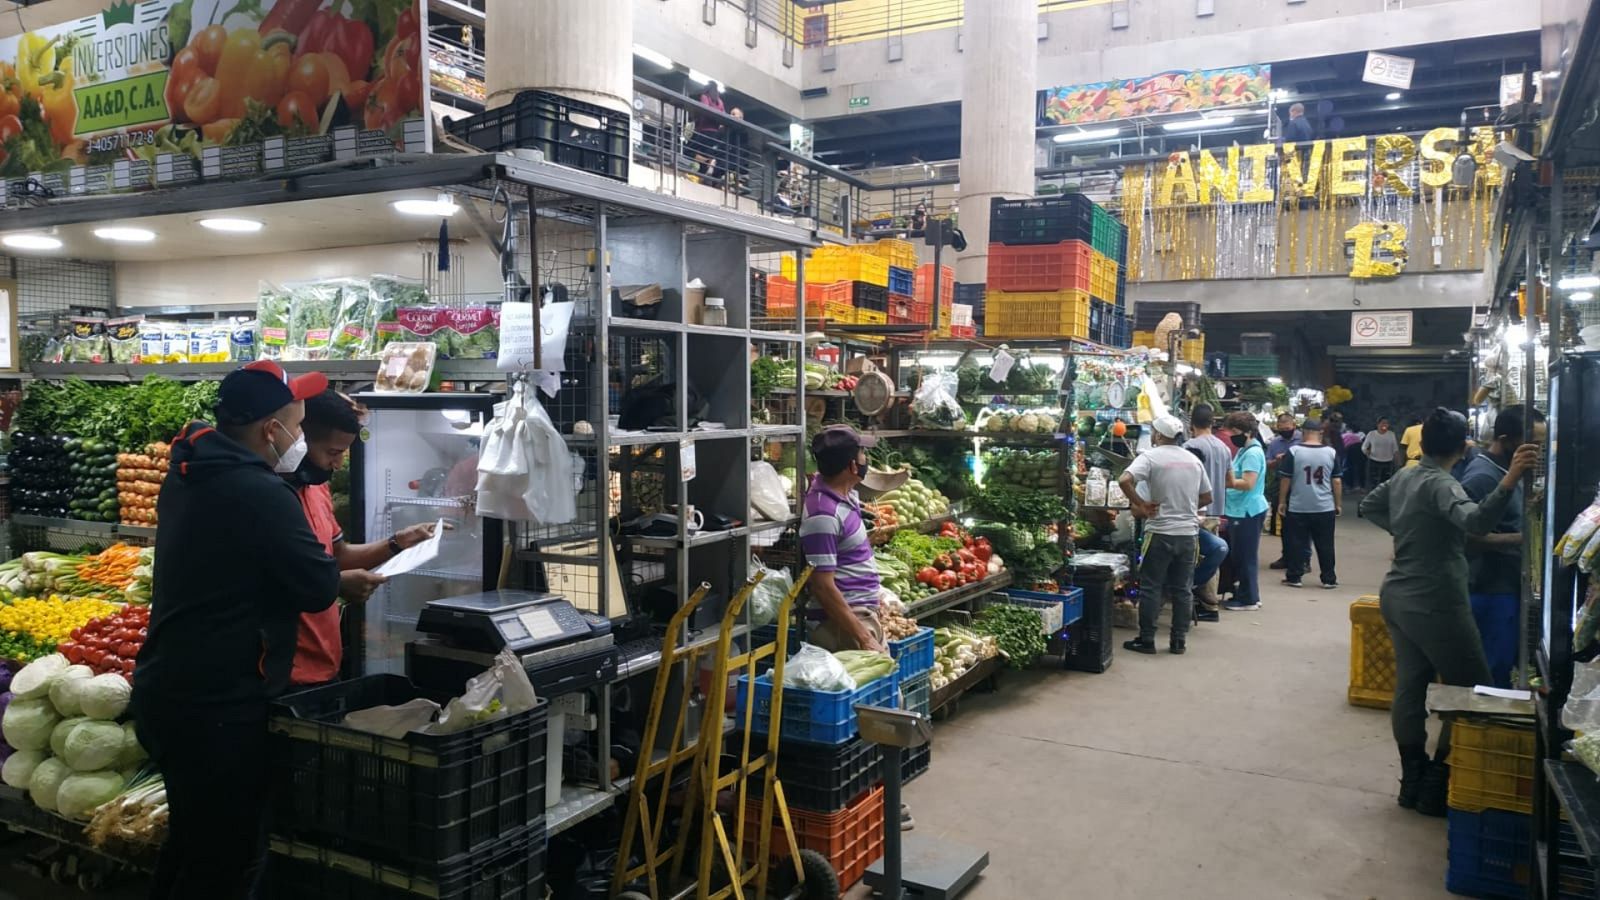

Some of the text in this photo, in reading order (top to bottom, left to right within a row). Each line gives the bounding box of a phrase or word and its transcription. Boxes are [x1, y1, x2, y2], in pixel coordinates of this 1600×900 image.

[73, 26, 168, 77] INVERSIONES
[86, 129, 154, 154] J-40571172-8
[1303, 463, 1324, 485] 14
